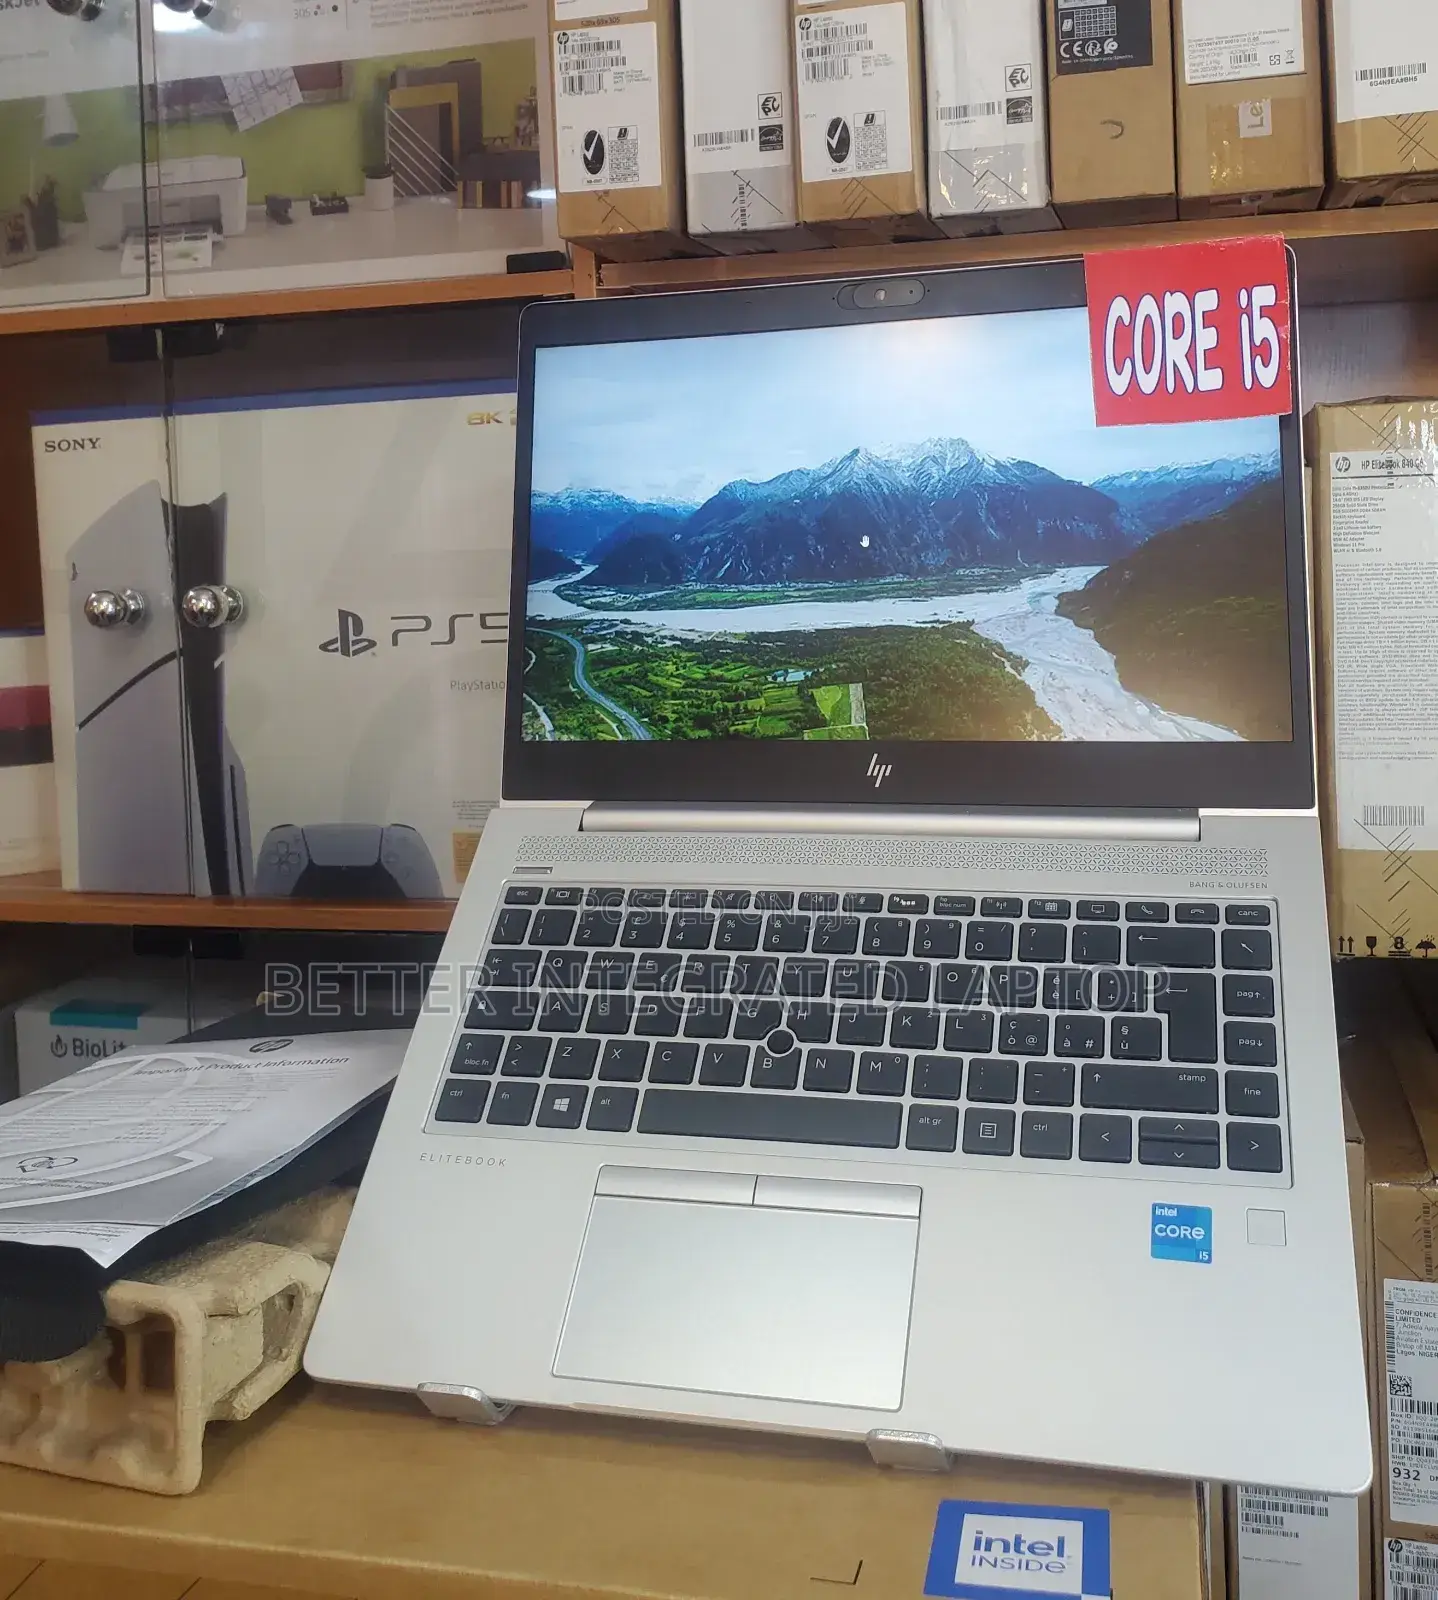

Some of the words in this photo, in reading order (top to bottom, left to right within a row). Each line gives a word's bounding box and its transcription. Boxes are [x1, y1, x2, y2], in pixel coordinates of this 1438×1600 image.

[1104, 288, 1224, 397] CORE
[1238, 284, 1281, 392] i5
[467, 410, 503, 425] 8K
[44, 437, 101, 453] SONY
[1362, 460, 1370, 470] HP
[390, 612, 508, 647] PS5
[450, 680, 505, 691] PlayStatio
[1189, 881, 1215, 889] BANG
[1226, 882, 1268, 890] OLUFSEN
[727, 920, 736, 928] %
[583, 930, 590, 938] 2
[629, 930, 638, 939] 3
[676, 932, 684, 940] 4
[1030, 928, 1036, 936] ?
[724, 934, 732, 942] 5
[772, 934, 780, 944] 6
[822, 936, 830, 945] 7
[872, 938, 880, 947] 8
[1394, 936, 1404, 950] 8
[924, 940, 932, 949] 9
[552, 958, 563, 968] Q
[600, 959, 614, 968] W
[646, 960, 655, 970] E
[694, 962, 702, 972] R
[742, 964, 750, 973] T
[792, 965, 802, 976] Y
[842, 967, 853, 977] U
[1000, 974, 1008, 984] P
[552, 1002, 562, 1011] A
[600, 1002, 608, 1012] S
[647, 1004, 657, 1014] D
[748, 1008, 757, 1018] G
[796, 1010, 807, 1020] H
[848, 1013, 857, 1022] J
[902, 1016, 912, 1026] K
[956, 1019, 964, 1029] L
[1026, 1034, 1038, 1046] @
[1064, 1038, 1070, 1048] à
[1085, 1040, 1094, 1048] #
[1121, 1040, 1128, 1050] ù
[73, 1038, 126, 1057] BioLit
[562, 1046, 572, 1057] Z
[612, 1048, 622, 1059] X
[662, 1050, 672, 1062] C
[713, 1053, 724, 1064] V
[133, 1065, 203, 1076] Important
[205, 1062, 262, 1071] Product
[263, 1057, 350, 1068] Information
[464, 1058, 480, 1066] bloc
[762, 1058, 772, 1069] B
[816, 1058, 826, 1069] N
[870, 1061, 882, 1072] M
[1178, 1074, 1206, 1082] stamp
[1244, 1087, 1262, 1096] fine
[932, 1117, 942, 1126] gr
[1033, 1123, 1048, 1132] ctrl
[419, 1153, 507, 1167] ELITEBOOK
[1155, 1206, 1178, 1217] intel
[1396, 1308, 1437, 1318] CONFIDENCE
[1396, 1316, 1420, 1324] LIMITED
[1392, 1467, 1420, 1481] 932
[972, 1529, 1066, 1559] intel
